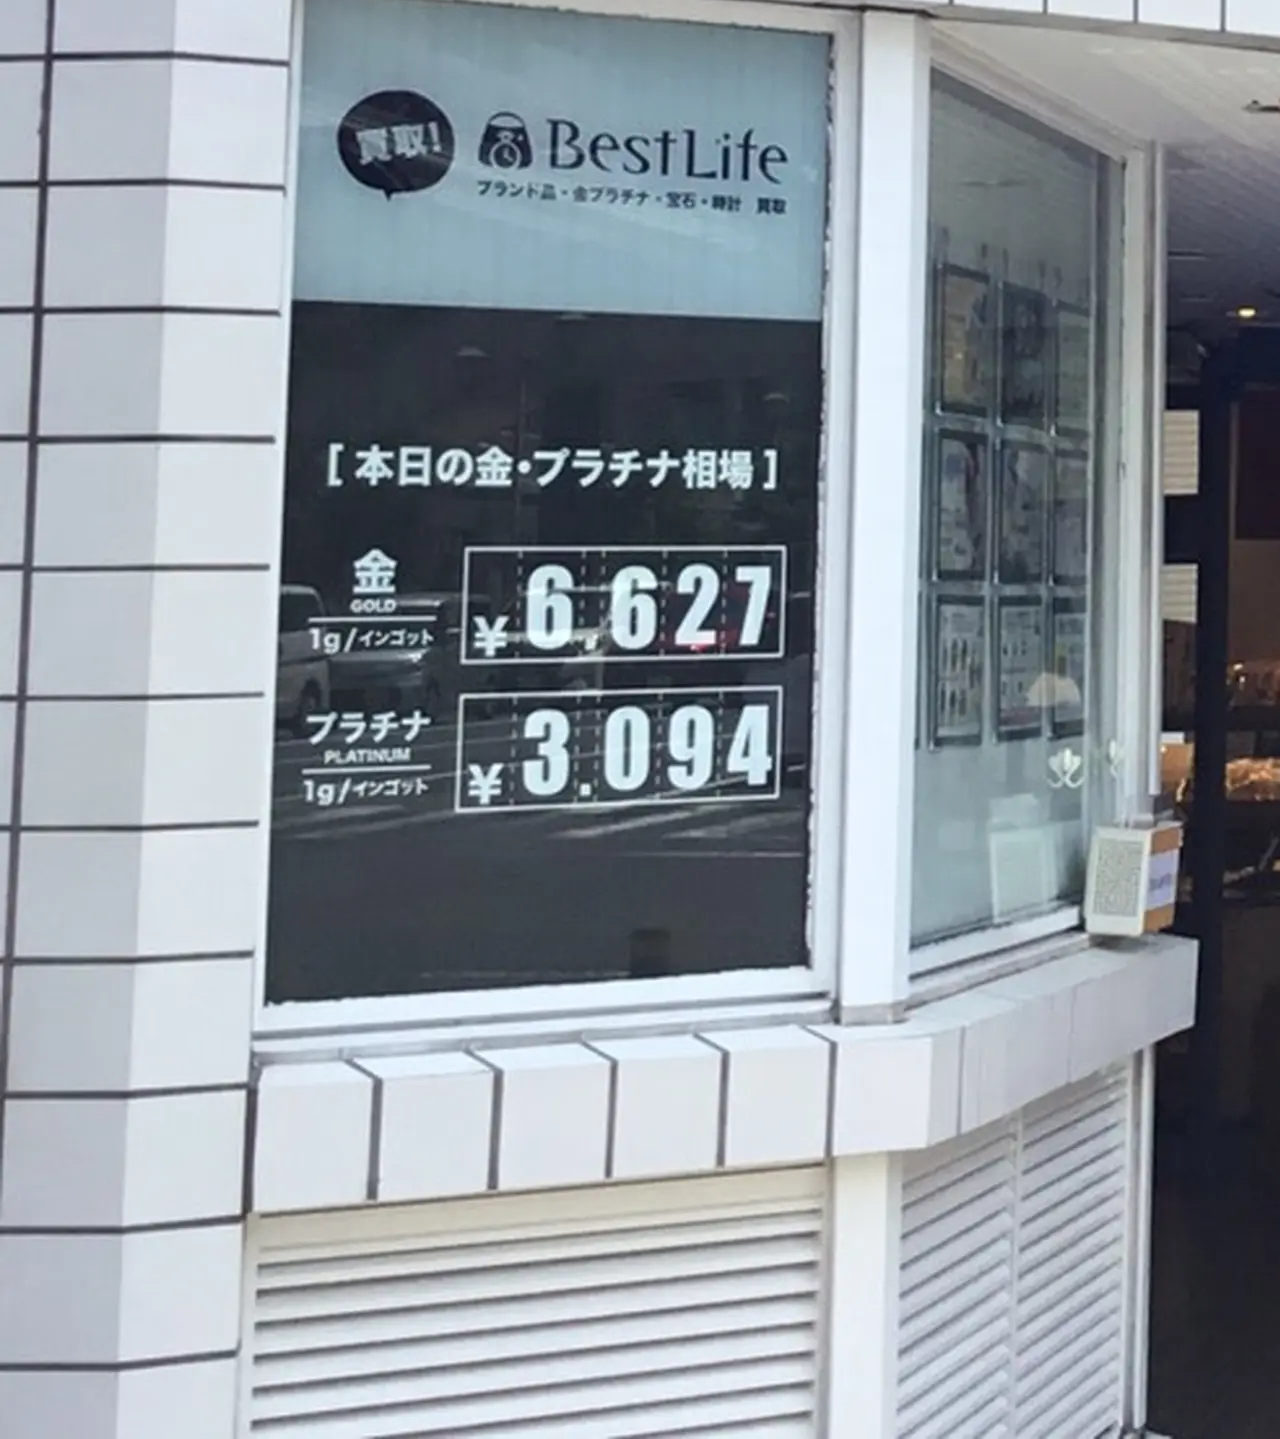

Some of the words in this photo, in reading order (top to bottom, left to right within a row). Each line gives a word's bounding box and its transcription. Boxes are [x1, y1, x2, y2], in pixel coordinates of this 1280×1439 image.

[546, 118, 789, 185] BestLife
[352, 548, 398, 594] 金
[350, 598, 397, 614] GOLD
[305, 709, 432, 745] プラチナ
[324, 747, 412, 765] PLATINUM
